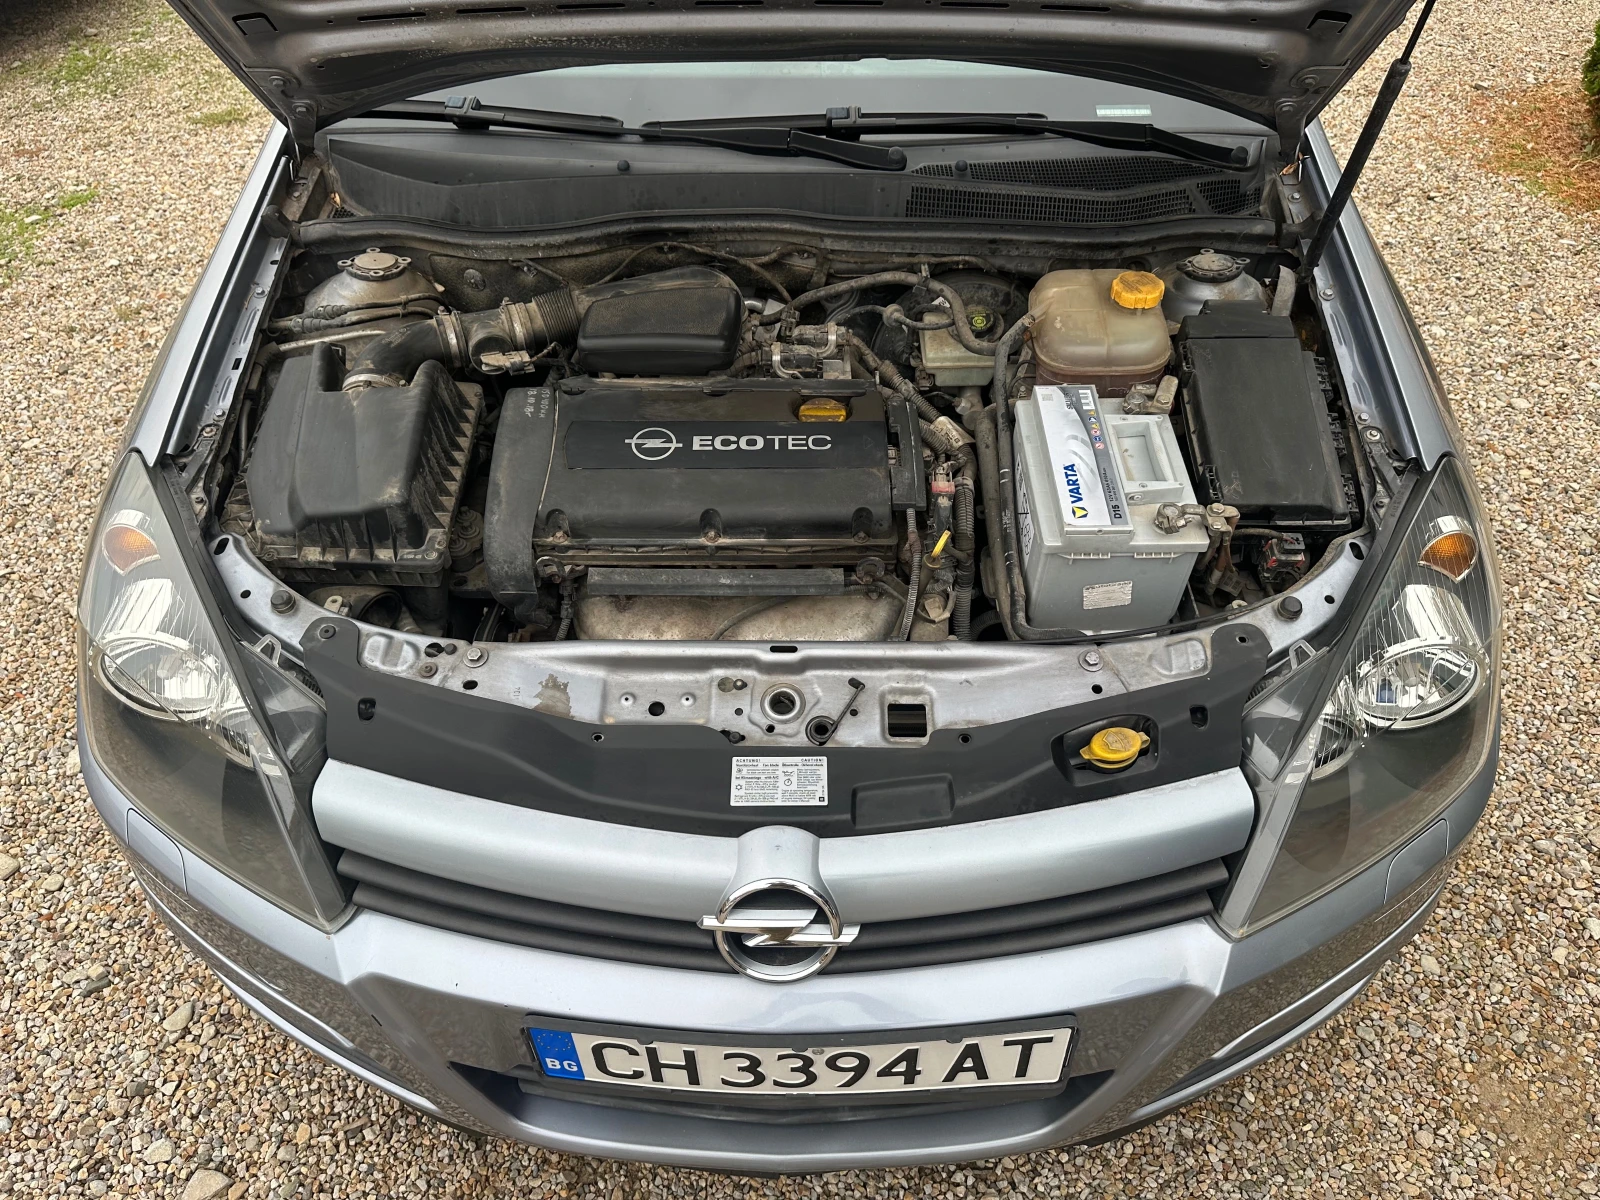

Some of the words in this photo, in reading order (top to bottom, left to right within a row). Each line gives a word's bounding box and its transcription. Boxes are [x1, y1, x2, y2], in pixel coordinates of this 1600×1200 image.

[692, 435, 832, 451] ECOTEC
[1063, 463, 1083, 504] VARTA
[1111, 504, 1122, 519] D15
[545, 1057, 578, 1072] BG
[591, 1041, 701, 1086] CH
[720, 1047, 922, 1088] 3394
[941, 1036, 1054, 1083] AT
